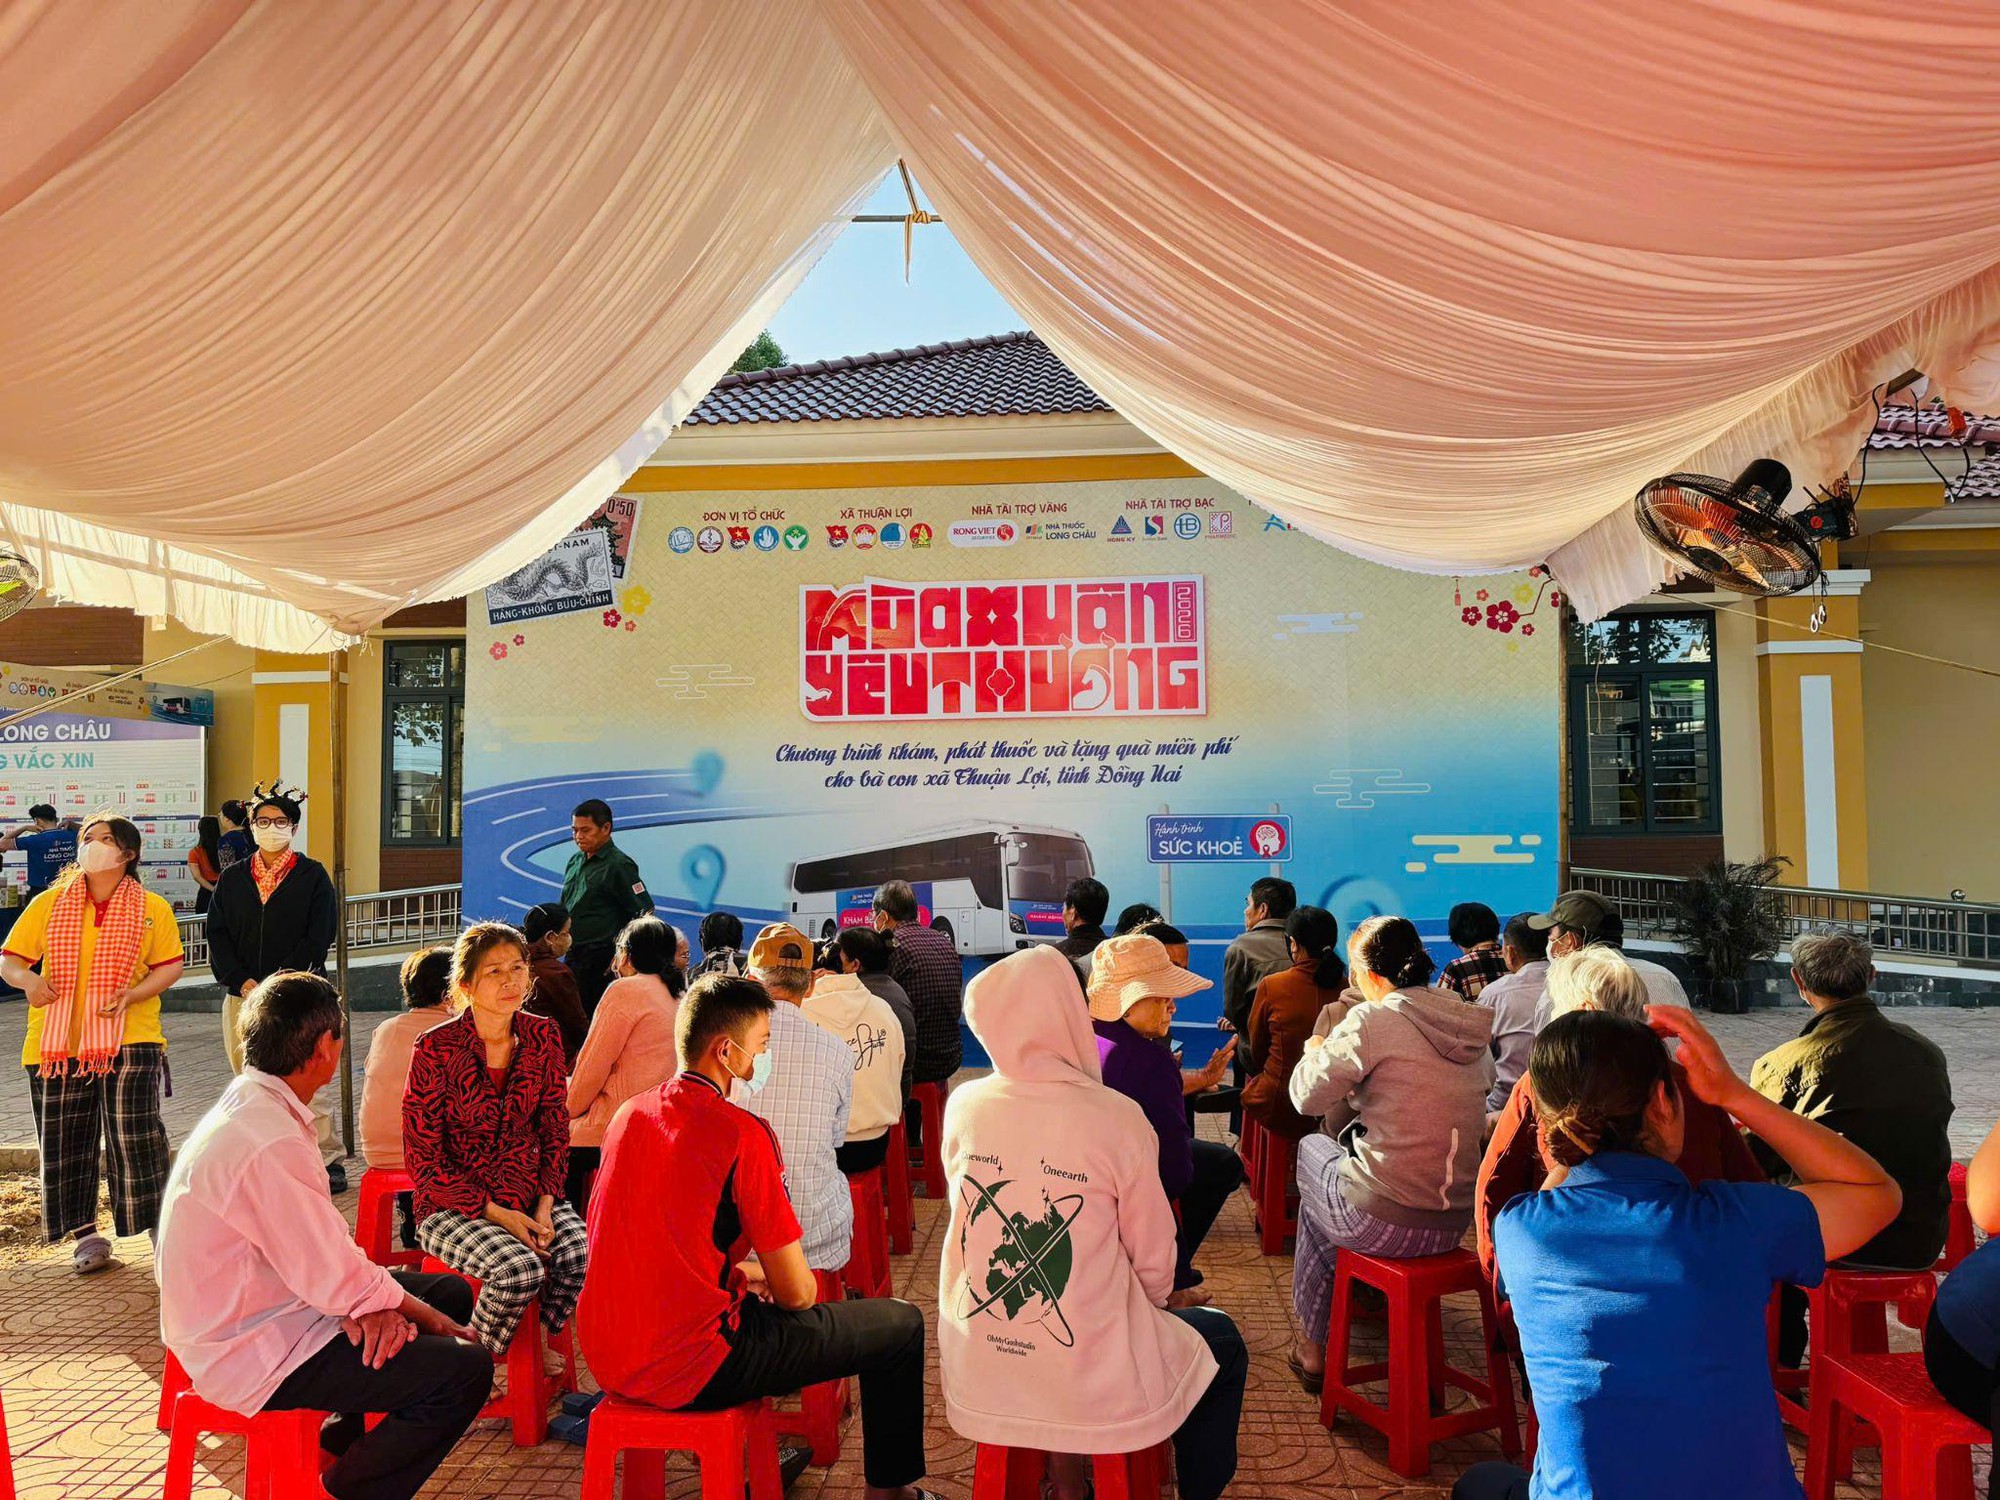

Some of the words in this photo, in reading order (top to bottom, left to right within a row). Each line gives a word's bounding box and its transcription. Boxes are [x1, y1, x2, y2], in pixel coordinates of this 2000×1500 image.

[971, 503, 993, 515] NHÀ
[996, 502, 1011, 514] TÀI
[1014, 503, 1036, 515] TRỢ
[1039, 502, 1068, 514] VÀNG
[1125, 498, 1147, 510] NHÀ
[1151, 498, 1166, 509] TÀI
[1169, 497, 1191, 510] TRỢ
[1195, 497, 1215, 510] BẠC
[703, 510, 726, 521] ĐƠN
[729, 511, 740, 523] VỊ
[741, 506, 758, 521] TỔ
[760, 508, 786, 520] CHỨC
[840, 507, 855, 520] XÃ
[858, 507, 892, 521] THUẬN
[895, 508, 912, 519] LỢI
[1045, 522, 1060, 530] NHÀ
[1061, 520, 1085, 530] THUỐC
[1045, 531, 1070, 540] LONG
[1072, 528, 1097, 539] CHÂU
[55, 719, 111, 740] CHÂU
[14, 746, 55, 769] VẮC
[62, 752, 95, 768] XIN
[775, 743, 836, 766] Chương
[842, 742, 882, 761] trình
[888, 742, 938, 762] khám,
[944, 740, 987, 764] phát
[991, 738, 1037, 758] thuốc
[1043, 741, 1069, 757] và
[1072, 738, 1110, 761] tặng
[1115, 739, 1152, 761] quà
[1155, 737, 1196, 756] miễn
[1201, 735, 1240, 760] phí
[825, 770, 855, 788] cho
[860, 770, 885, 787] bà
[888, 772, 918, 787] con
[923, 770, 950, 786] xã
[954, 767, 1011, 790] Thuận
[1016, 766, 1051, 789] Lợi,
[1057, 765, 1090, 784] tỉnh
[1095, 765, 1145, 788] Đồng
[1150, 764, 1183, 783] Nai
[1154, 821, 1180, 837] Hành
[1181, 819, 1204, 835] trình
[1158, 836, 1193, 855] SỨC
[1043, 1165, 1089, 1184] Oneearth
